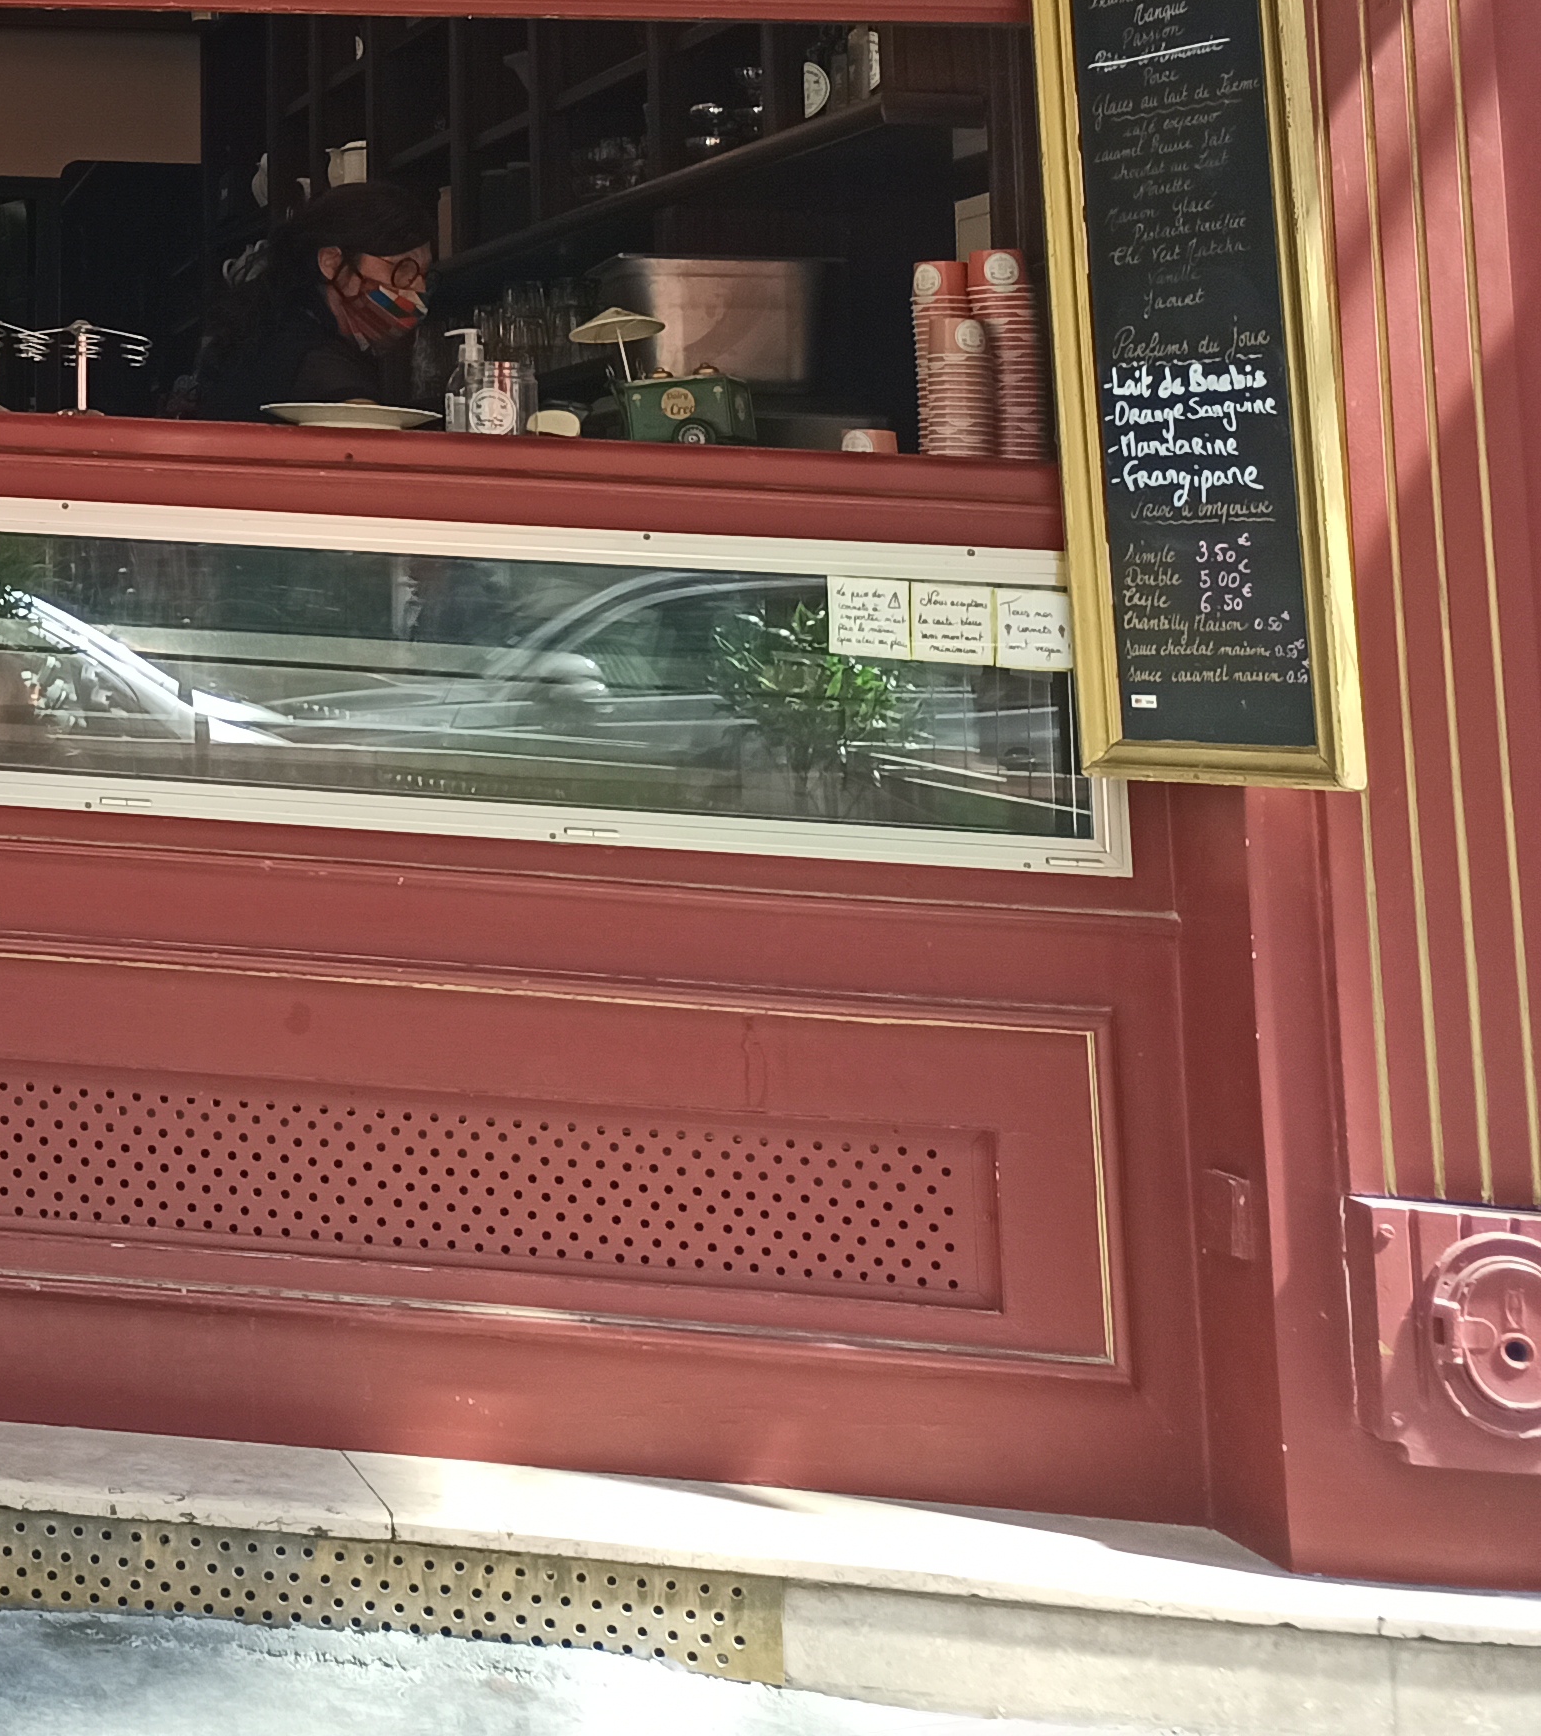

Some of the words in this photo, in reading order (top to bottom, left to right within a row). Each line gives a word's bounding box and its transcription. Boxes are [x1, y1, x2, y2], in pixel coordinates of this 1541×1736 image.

[1112, 325, 1189, 366] Parfums
[1198, 335, 1220, 355] du
[1157, 366, 1185, 399] de
[1186, 392, 1278, 432] Sanguine
[1124, 566, 1183, 586] Double
[1123, 611, 1189, 645] Chantilly
[1160, 637, 1214, 656] chocolat
[1171, 664, 1229, 683] caramel
